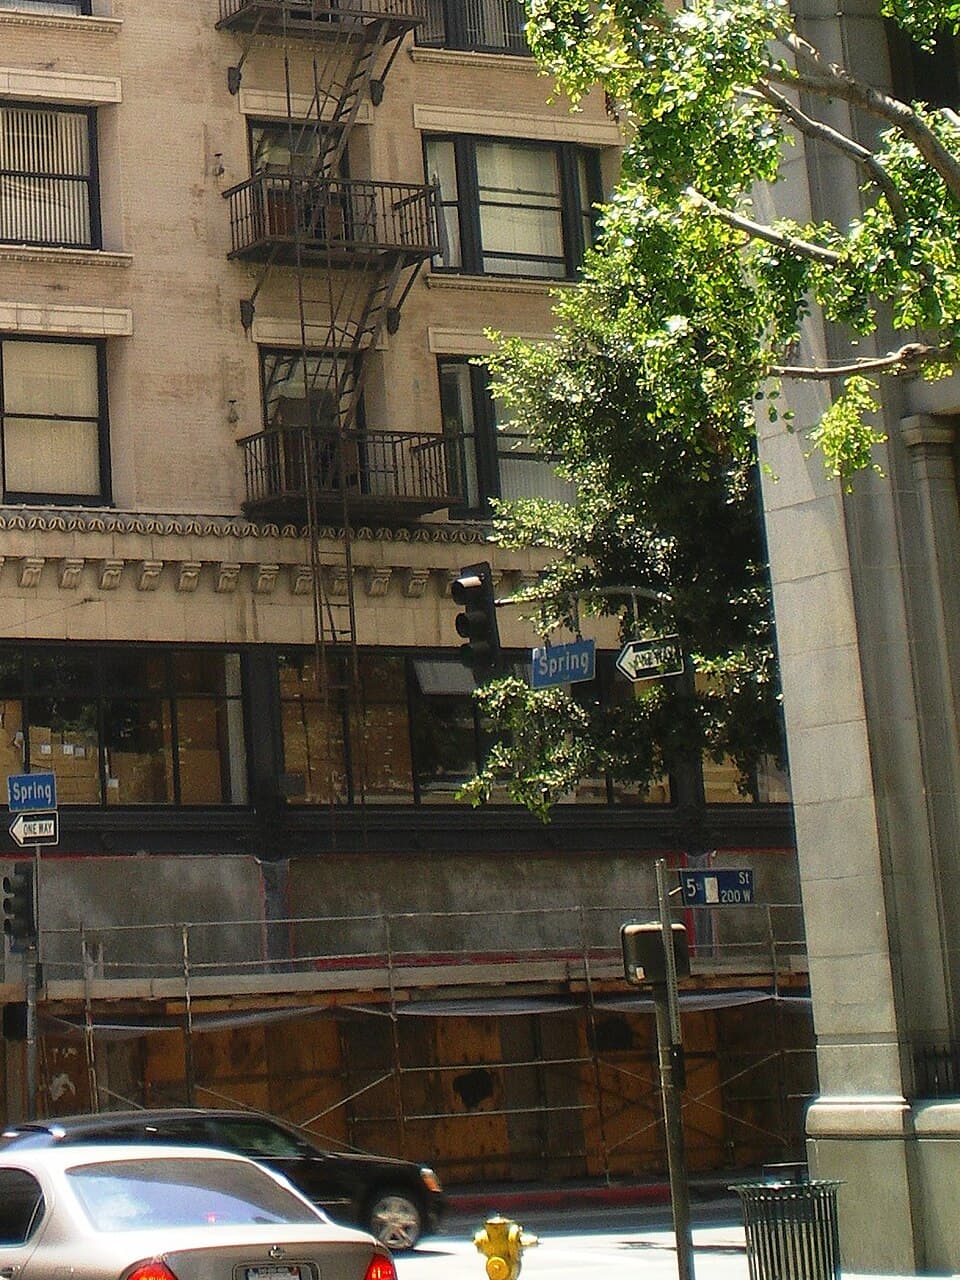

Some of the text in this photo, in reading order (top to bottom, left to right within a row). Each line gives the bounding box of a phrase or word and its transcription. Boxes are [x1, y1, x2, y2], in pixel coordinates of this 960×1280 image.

[539, 651, 589, 676] Spring
[13, 781, 52, 805] Spring
[23, 823, 52, 835] ONE WAY
[739, 871, 749, 885] St
[721, 890, 740, 903] 200
